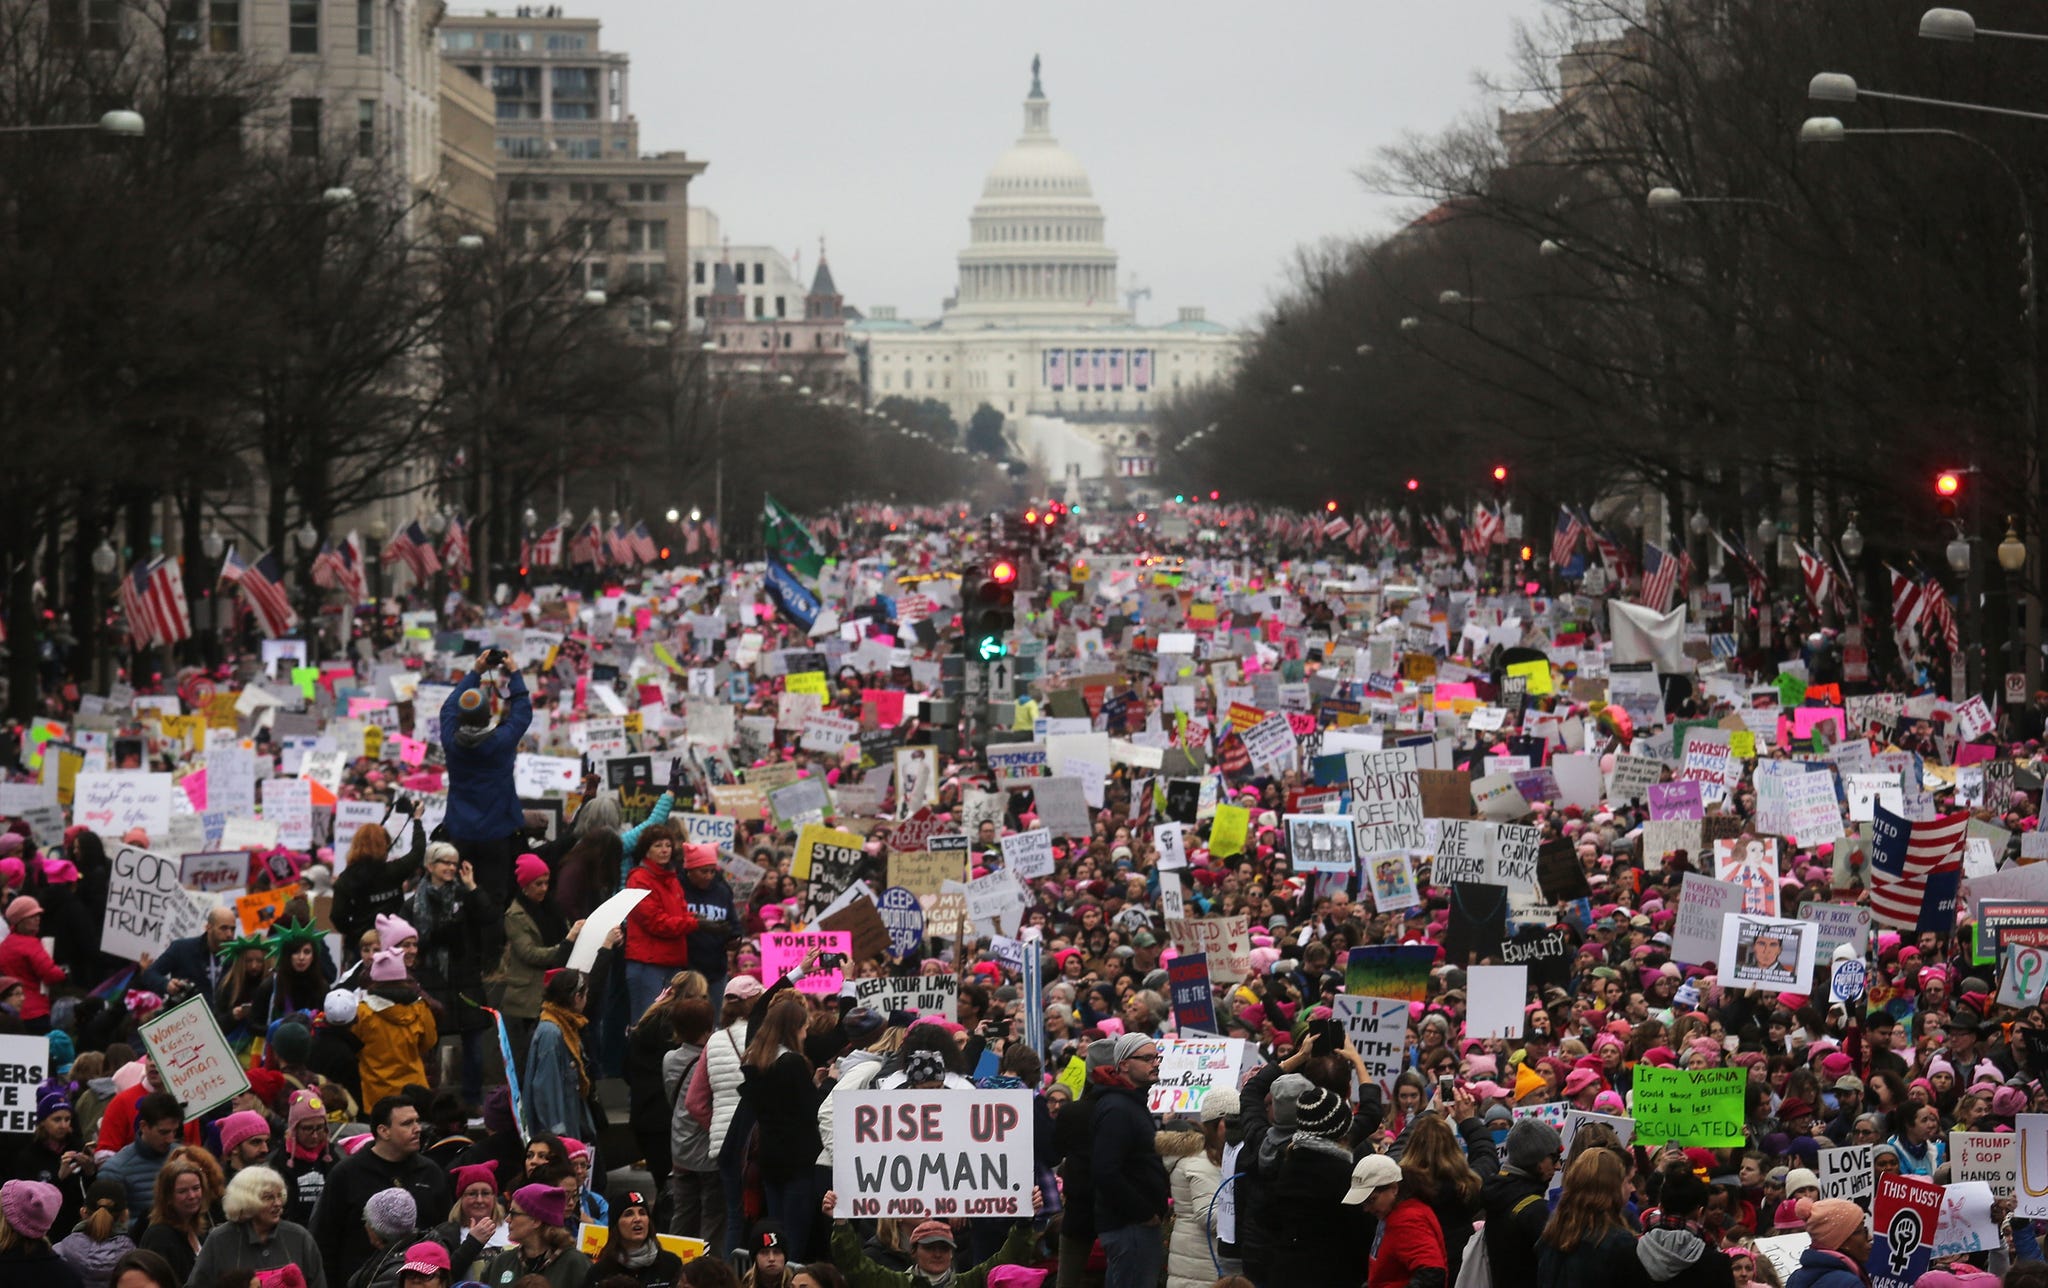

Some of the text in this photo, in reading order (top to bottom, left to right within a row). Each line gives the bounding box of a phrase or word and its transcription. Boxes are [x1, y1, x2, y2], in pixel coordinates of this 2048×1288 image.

[1503, 677, 1526, 692] NO!
[1689, 741, 1731, 758] DIVERSITY
[1362, 752, 1408, 775] KEEP
[1688, 754, 1726, 770] MAKES
[1683, 767, 1725, 785] AMERICA
[1350, 771, 1421, 802] RAPISTS
[1358, 801, 1421, 826] OFF MY
[1360, 823, 1426, 852] CAMPUS
[1441, 820, 1470, 841] WE
[1498, 825, 1540, 845] NEVER
[813, 843, 862, 866] STOP
[1437, 841, 1467, 857] ARE
[115, 848, 177, 893] GOD
[1436, 857, 1484, 875] CITIZENS
[1498, 860, 1536, 883] BACK
[883, 889, 914, 909] KEEP
[1684, 892, 1720, 909] RIGHTS
[1228, 920, 1246, 937] WE
[1681, 914, 1718, 929] HUMAN
[1679, 926, 1717, 940] RIGHTS
[1819, 924, 1857, 938] DECISION
[773, 935, 838, 947] WOMENS
[1501, 931, 1564, 963] EQUALITY
[856, 977, 887, 1000] KEEP
[889, 977, 920, 993] YOUR
[926, 974, 957, 996] LAWS
[883, 996, 908, 1012] OFF
[918, 994, 945, 1011] OUR
[1350, 1017, 1379, 1033] I'M
[1689, 1072, 1738, 1084] VAGINA
[1701, 1085, 1741, 1097] BULLETS
[1668, 1103, 1682, 1113] be
[854, 1103, 1019, 1144] RISE UP
[1634, 1119, 1738, 1137] REGULATED
[1829, 1147, 1872, 1174] LOVE
[1976, 1152, 2002, 1163] GOP
[854, 1152, 1021, 1193] WOMAN.
[1961, 1171, 2001, 1181] HANDS
[1821, 1171, 1872, 1201] NOT HATE
[1883, 1180, 1941, 1208] THIS PUSSY
[852, 1197, 1018, 1218] NO MUD, NO LOTUS
